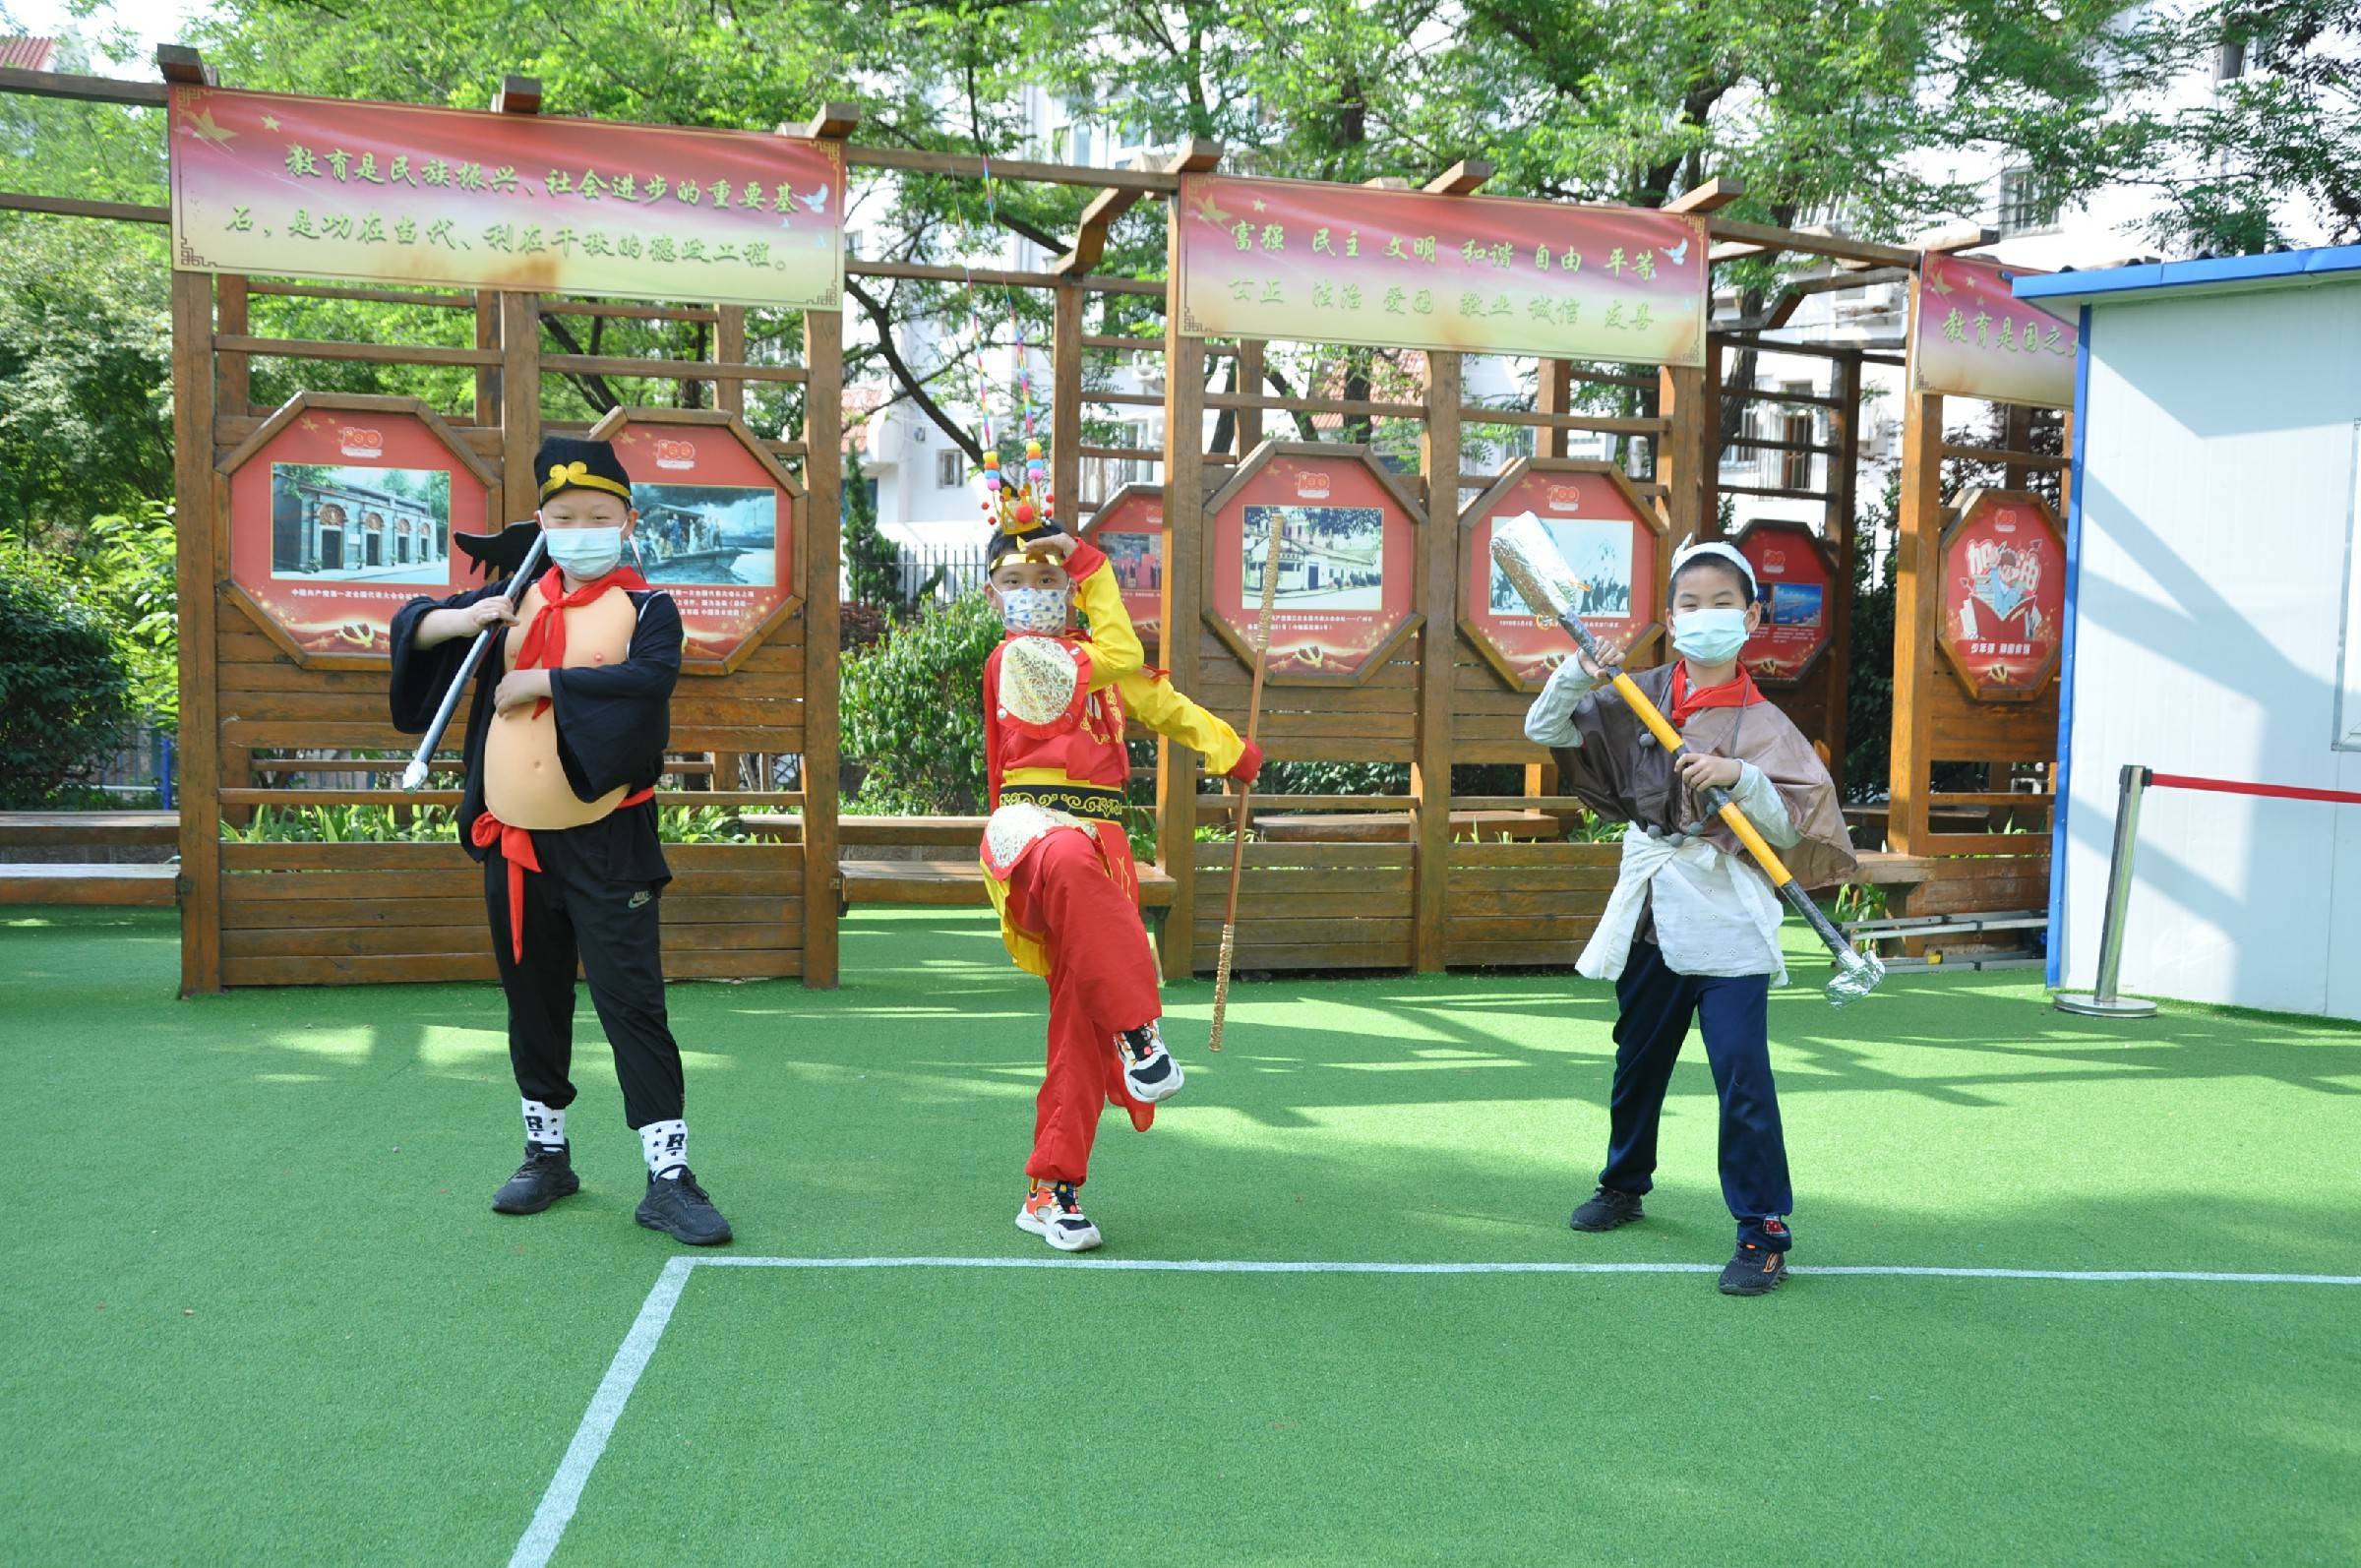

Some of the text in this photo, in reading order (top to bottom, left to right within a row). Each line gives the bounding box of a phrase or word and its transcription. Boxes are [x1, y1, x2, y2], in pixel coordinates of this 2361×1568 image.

[284, 145, 801, 214] 教育是民族振兴、社会进步的重要基
[1231, 220, 1656, 282] 富强 民主 文明 和谐 自由 平等
[1229, 277, 1656, 332] 公正 法治 爱国 敬业 诚信 友善
